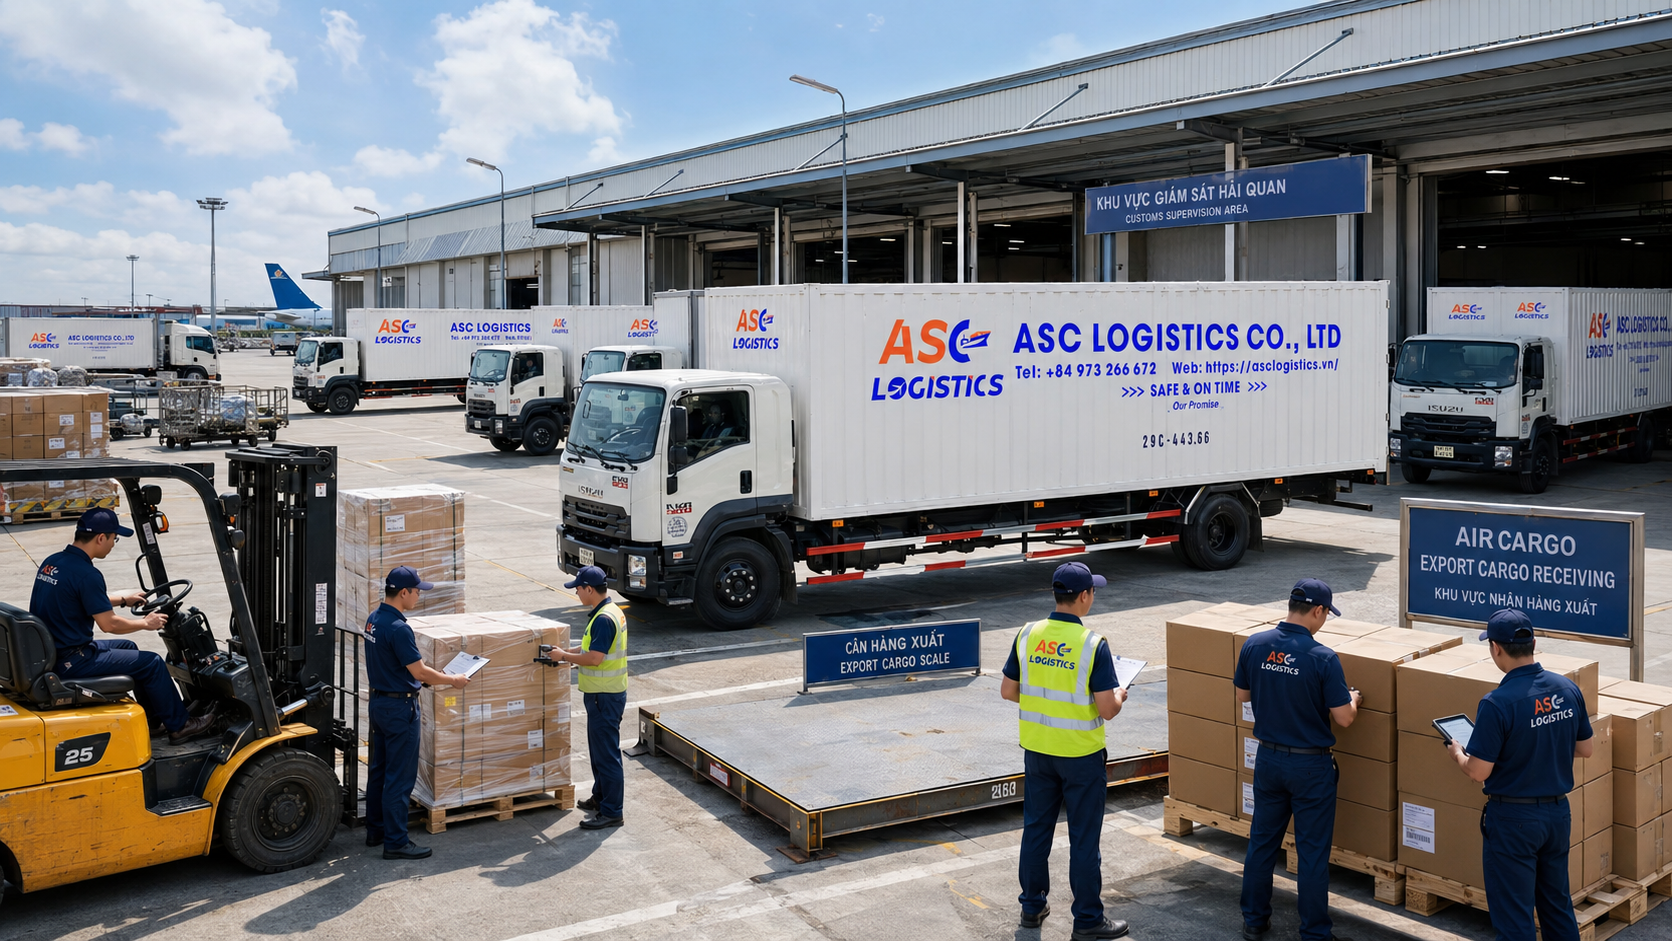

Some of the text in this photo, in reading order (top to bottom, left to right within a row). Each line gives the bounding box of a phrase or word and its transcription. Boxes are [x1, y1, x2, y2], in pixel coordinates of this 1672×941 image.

[1096, 195, 1120, 211] KHU
[1124, 192, 1150, 211] VỰC
[1154, 186, 1187, 205] GIÁM
[1191, 182, 1215, 202] SÁT
[1246, 178, 1286, 197] QUAN
[1125, 203, 1249, 224] CUSTOMS SUPERVISION AREA
[1451, 304, 1477, 314] ASC
[1517, 302, 1542, 312] ASC
[378, 318, 410, 334] ASC
[450, 322, 531, 333] ASC LOGISTICS
[736, 308, 767, 332] ASC
[375, 336, 422, 344] LOGISTICS
[733, 337, 779, 349] LOGISTICS
[878, 319, 971, 364] ASC
[1013, 323, 1341, 354] ASC LOGISTICS CO., LTD
[1015, 358, 1339, 379] Tel: +84 973 266 672 Web: https://asclogistics.vn/
[871, 374, 1004, 401] LOGISTICS
[1150, 381, 1240, 397] SAFE & ON TIME
[1173, 400, 1219, 410] Our Promise
[1428, 404, 1464, 412] ISUZU
[1455, 526, 1576, 557] AIR CARGO
[1420, 554, 1616, 589] EXPORT CARGO RECEIVING
[1434, 587, 1458, 601] KHU
[1461, 589, 1486, 605] VỰC
[1527, 594, 1561, 612] HÀNG
[1565, 597, 1597, 616] XUẤT
[845, 629, 945, 655] CÂN HÀNG XUẤT
[1034, 639, 1067, 657] ASC
[840, 652, 950, 674] EXPORT CARGO SCALE
[1029, 655, 1076, 670] LOGISTICS
[1266, 651, 1292, 665] ASC
[1534, 694, 1560, 715] ASC
[1531, 708, 1574, 728] LOGISTICS
[64, 746, 94, 766] 25
